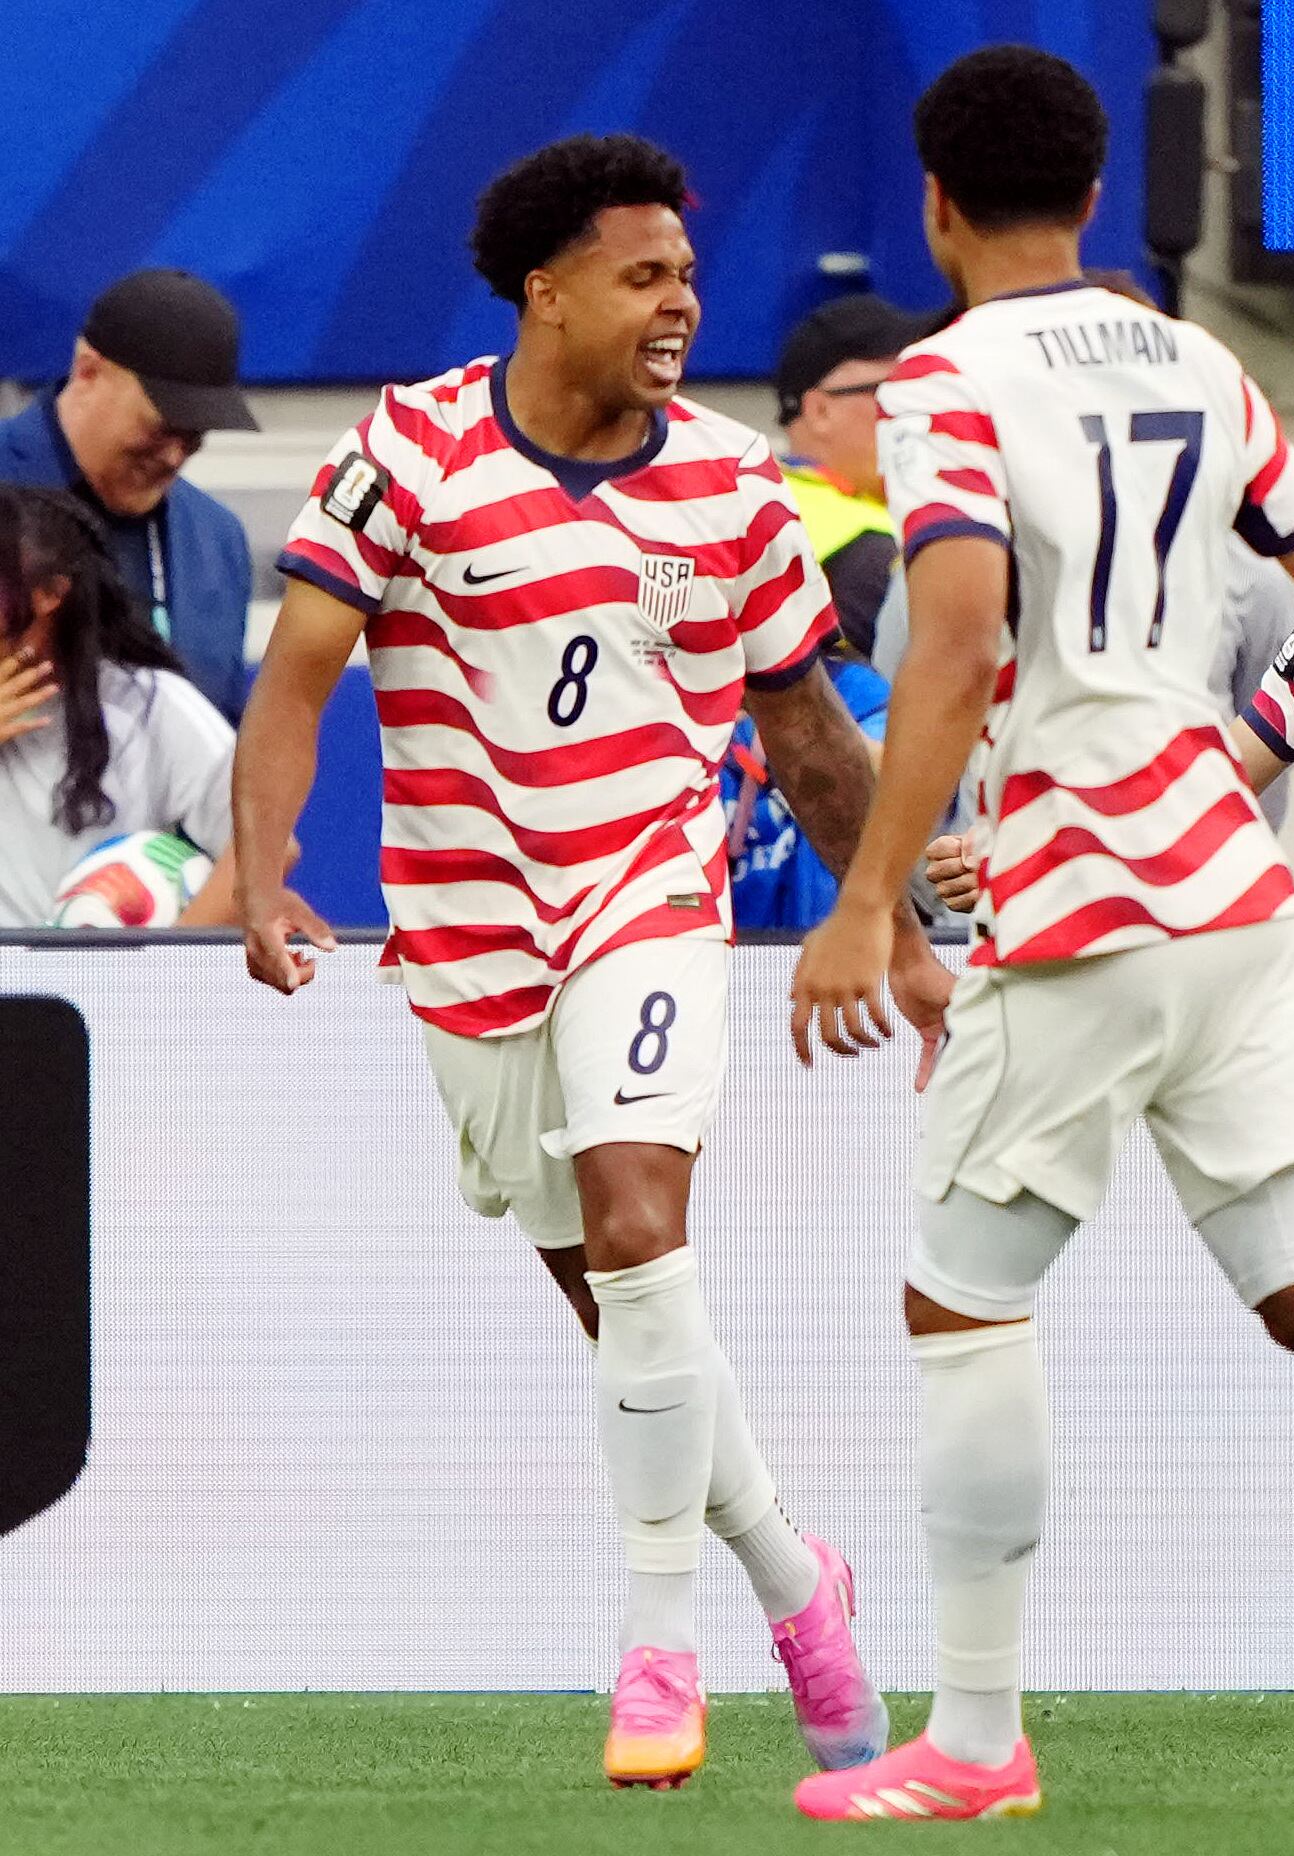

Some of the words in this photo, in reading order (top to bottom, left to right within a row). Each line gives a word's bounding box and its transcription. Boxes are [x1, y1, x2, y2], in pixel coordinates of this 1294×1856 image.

[1025, 320, 1180, 369] TILLMAN
[645, 559, 690, 588] USA
[1078, 411, 1205, 653] 17
[547, 635, 599, 727] 8
[628, 991, 677, 1075] 8
